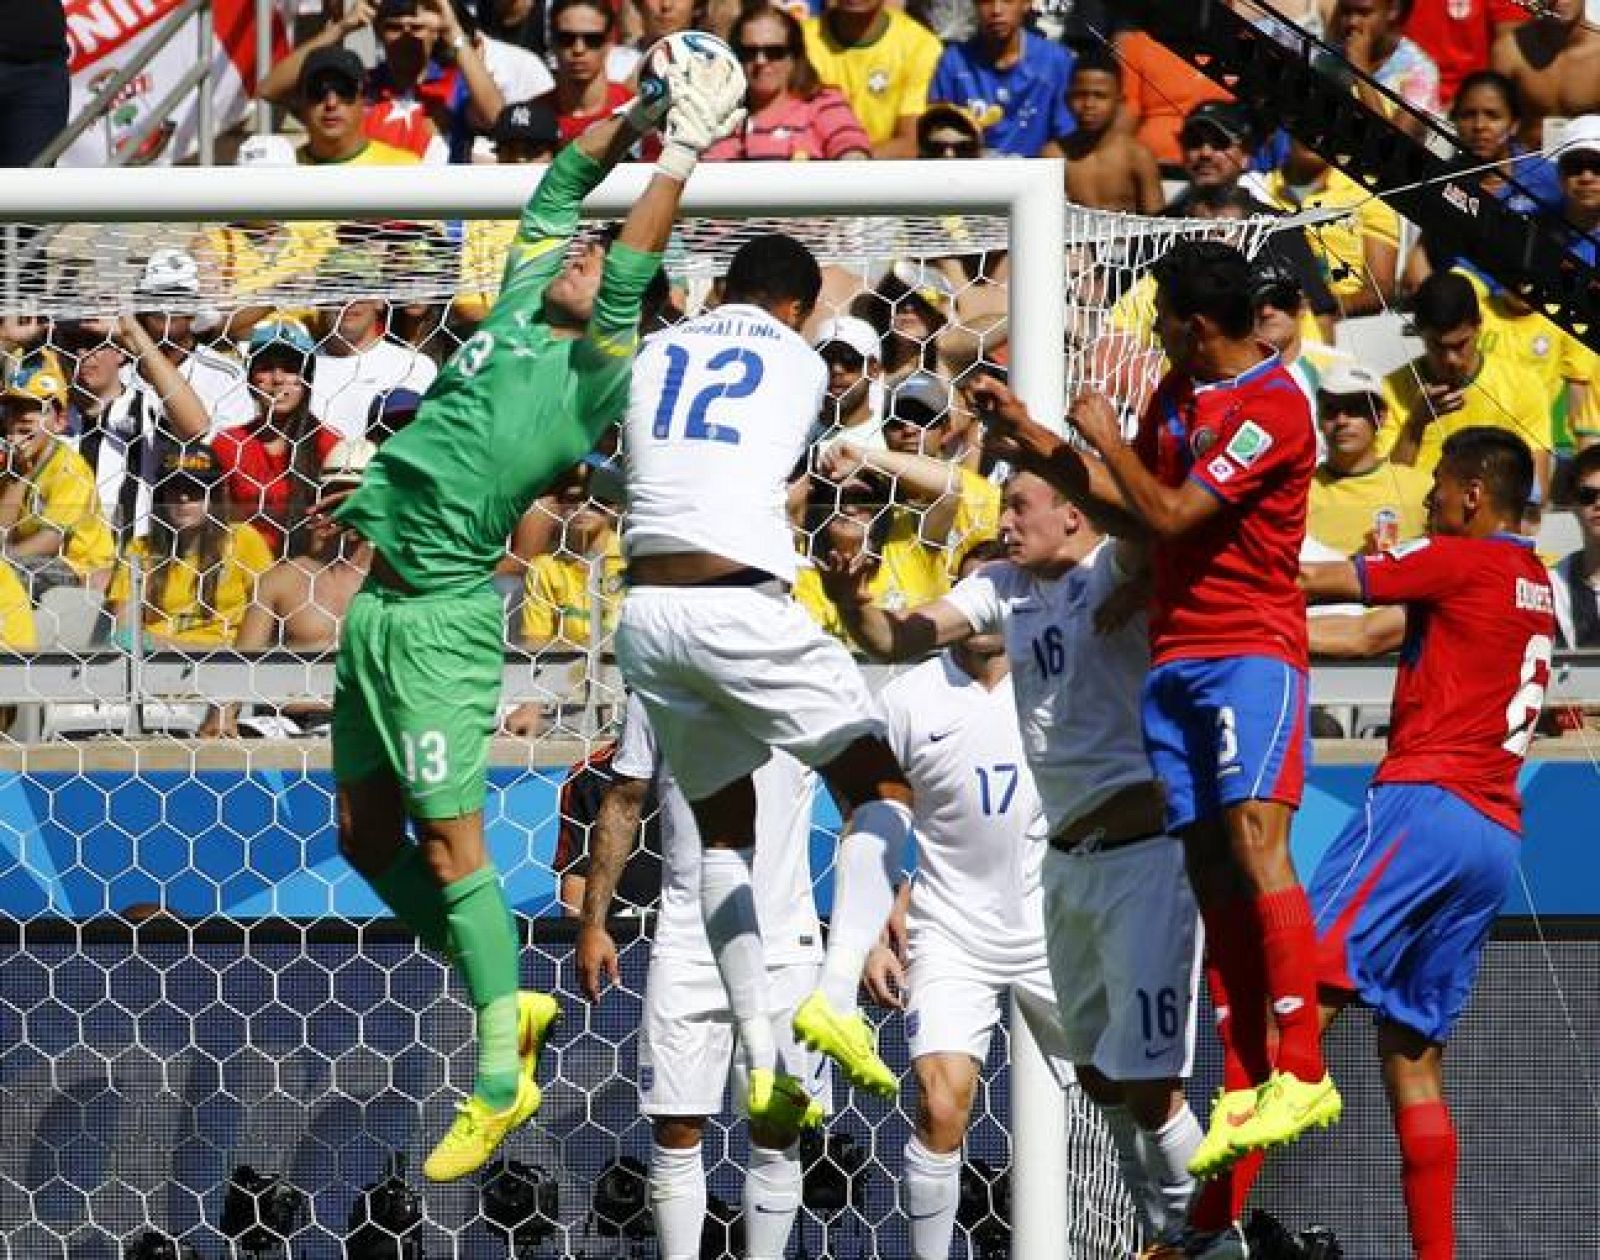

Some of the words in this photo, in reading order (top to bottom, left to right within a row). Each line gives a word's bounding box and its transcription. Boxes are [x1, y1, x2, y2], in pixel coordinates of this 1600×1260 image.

[450, 330, 494, 376] 3
[653, 344, 764, 445] 12
[1032, 625, 1065, 680] 16
[402, 730, 448, 783] 13
[1217, 706, 1238, 764] 3
[975, 763, 1018, 815] 17
[1136, 986, 1179, 1041] 16
